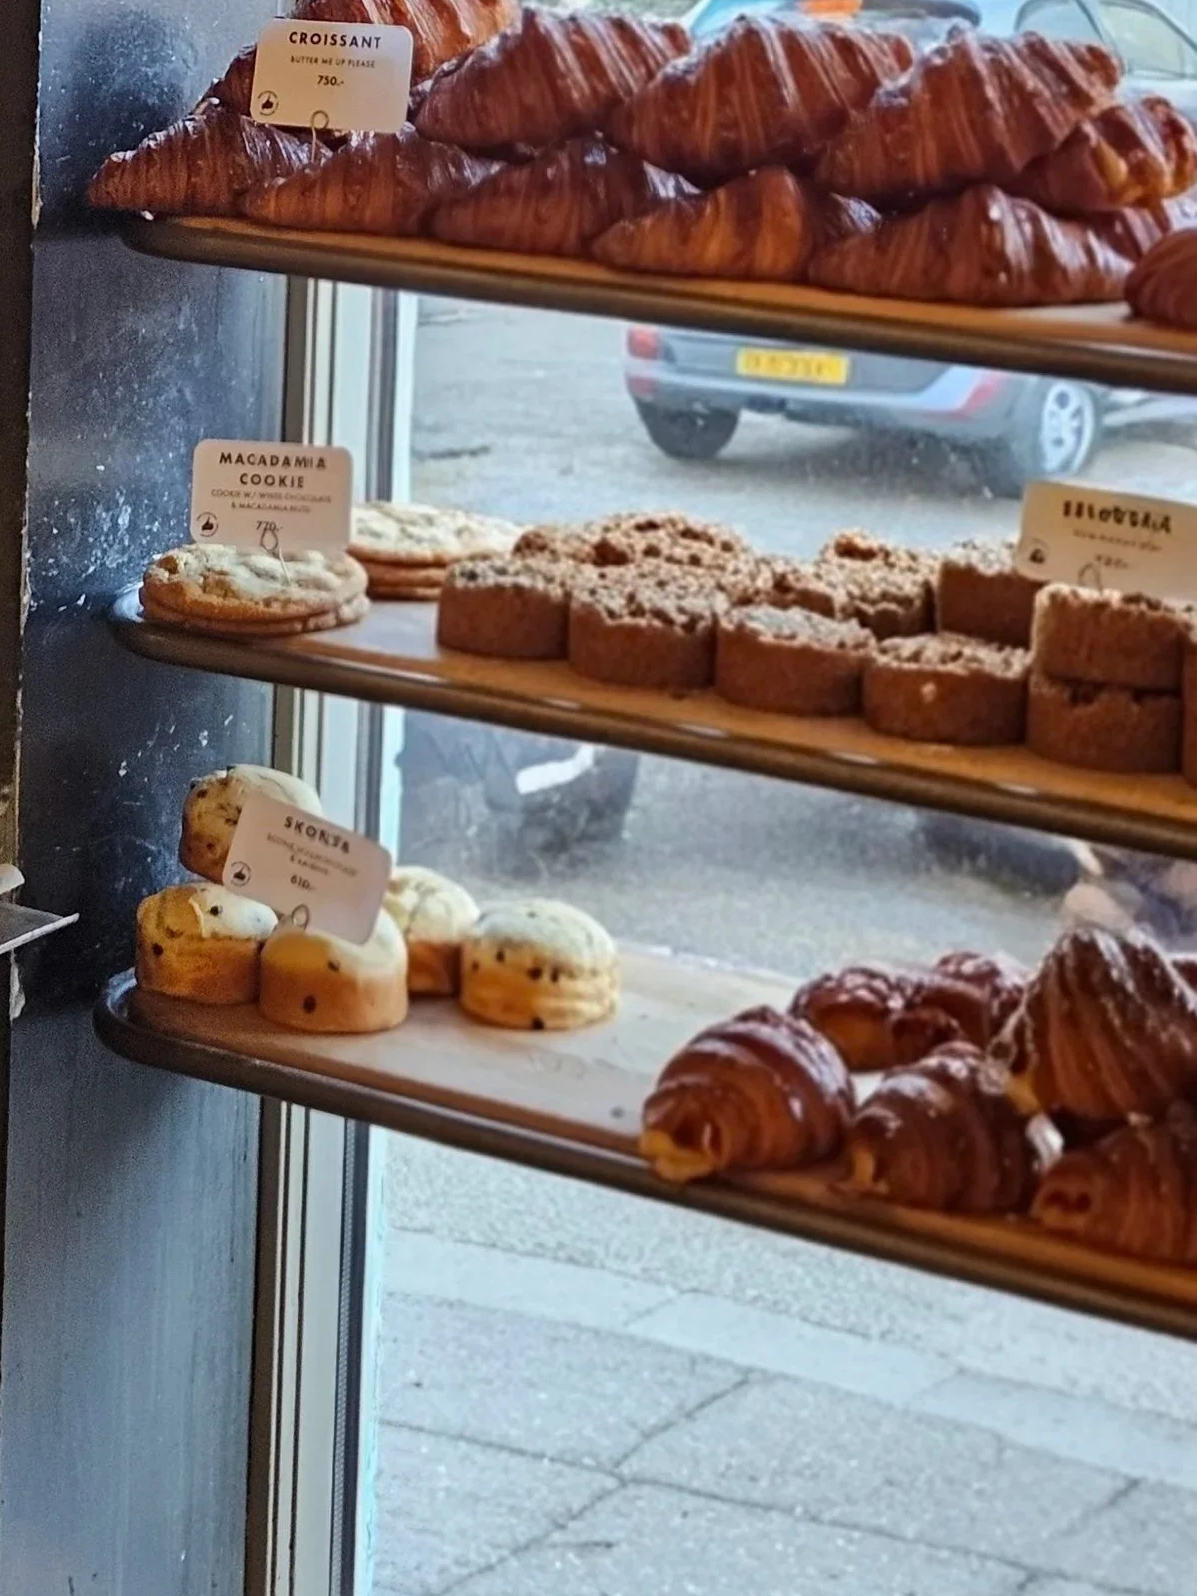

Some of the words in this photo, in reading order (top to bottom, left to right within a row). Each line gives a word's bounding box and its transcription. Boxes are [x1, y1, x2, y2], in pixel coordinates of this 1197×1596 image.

[289, 31, 382, 49] CROISSANT
[291, 55, 318, 64] BUTTER
[322, 57, 333, 66] ME
[335, 58, 346, 66] UP
[348, 59, 376, 69] PLEASE
[219, 452, 327, 469] MACADAMIA
[240, 472, 305, 488] COOKIE
[211, 489, 241, 498] COOKIE
[284, 815, 350, 854] SKONSA
